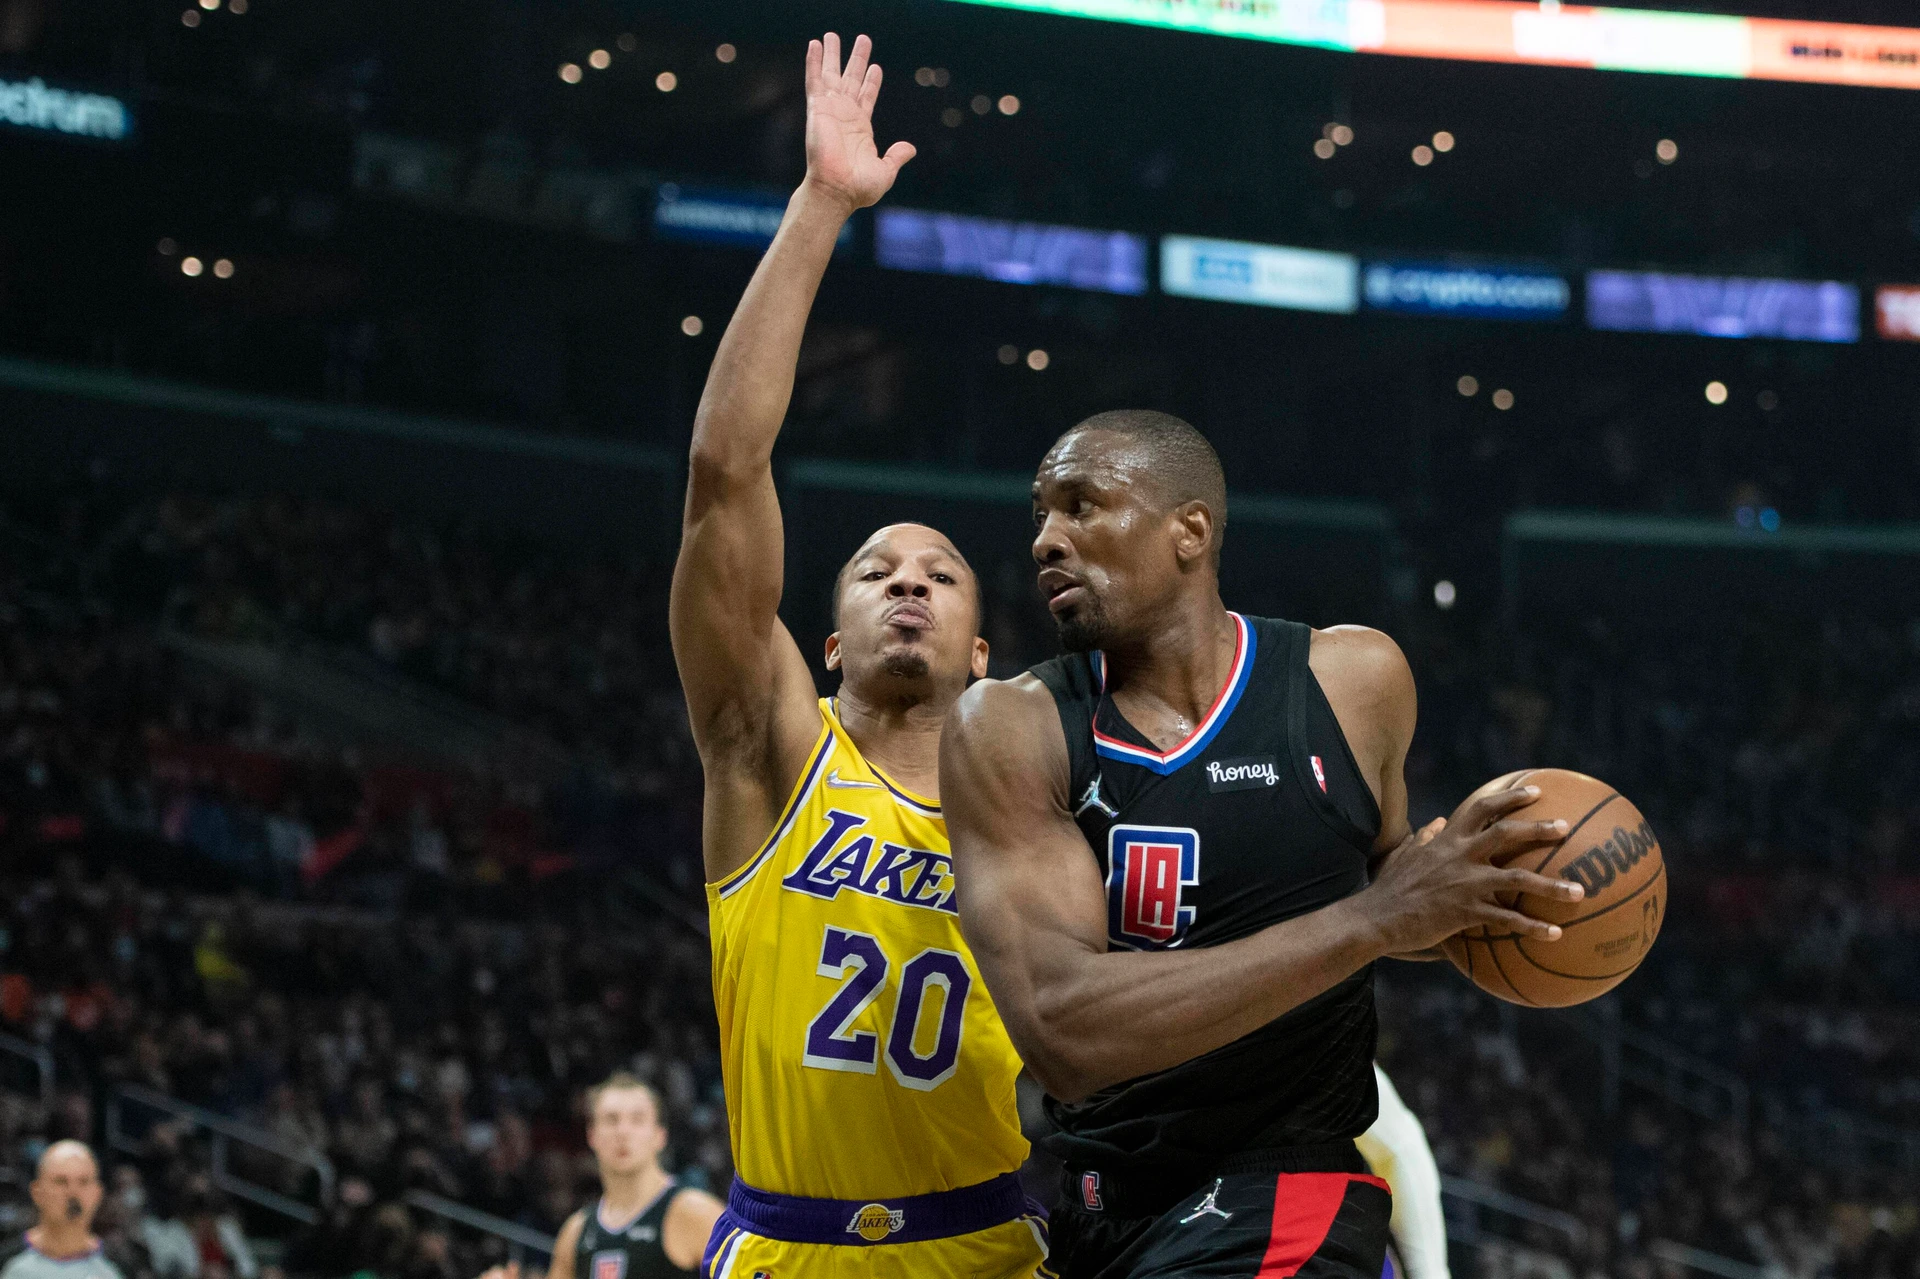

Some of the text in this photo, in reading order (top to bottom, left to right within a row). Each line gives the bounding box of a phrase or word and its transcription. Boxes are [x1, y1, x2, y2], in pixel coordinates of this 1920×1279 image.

[1206, 761, 1279, 786] honey
[782, 808, 959, 917] LAKE
[1558, 819, 1656, 899] Wilson
[802, 923, 973, 1092] 20
[850, 1213, 903, 1231] LAKERS
